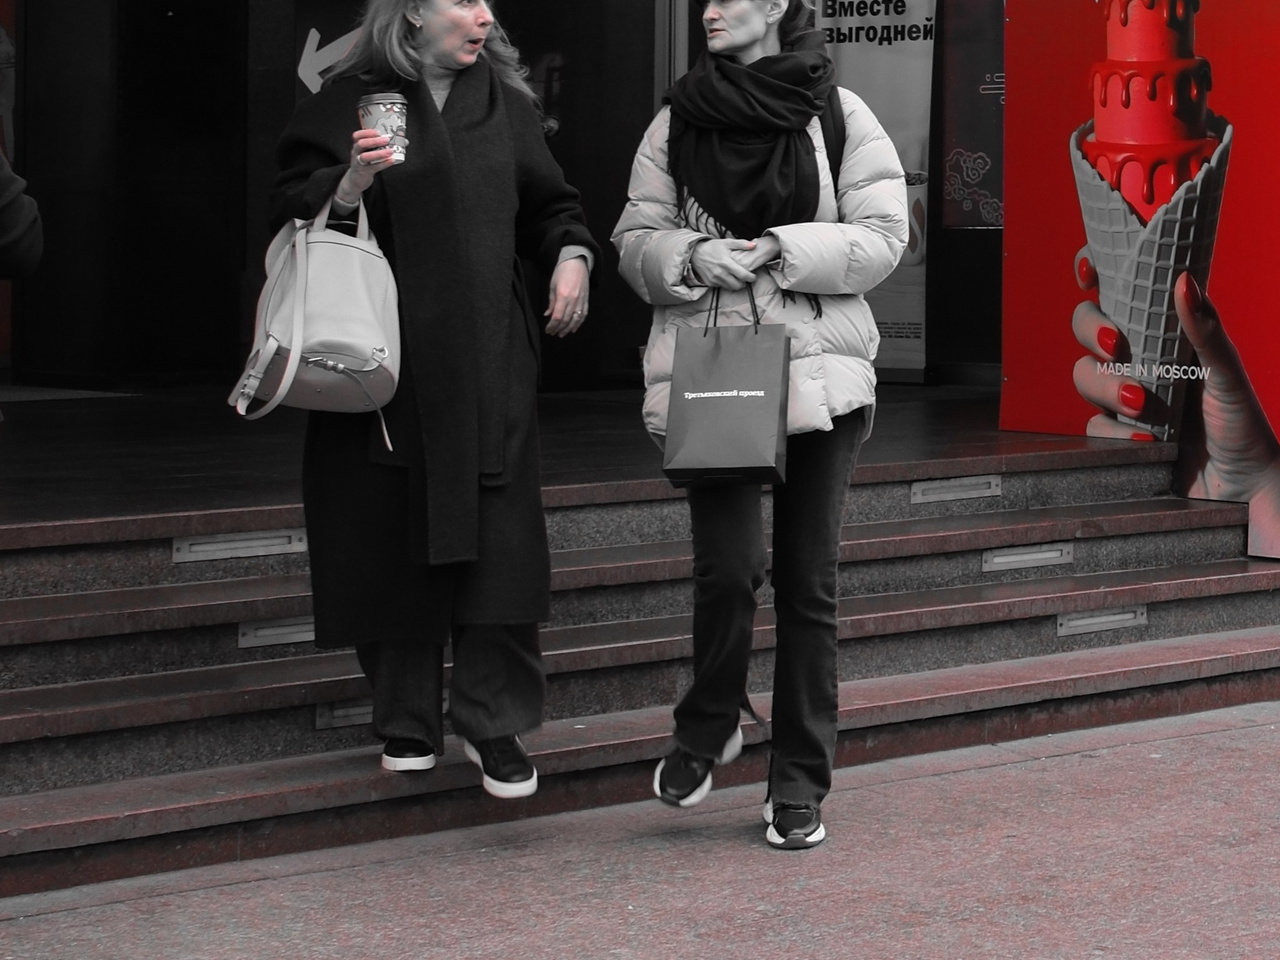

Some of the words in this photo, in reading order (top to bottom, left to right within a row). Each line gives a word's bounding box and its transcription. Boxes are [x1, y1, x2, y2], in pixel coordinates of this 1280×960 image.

[821, 16, 935, 46] выгодней
[1096, 361, 1131, 376] MADE
[1135, 364, 1148, 377] IN
[1152, 364, 1211, 380] MOSCOW
